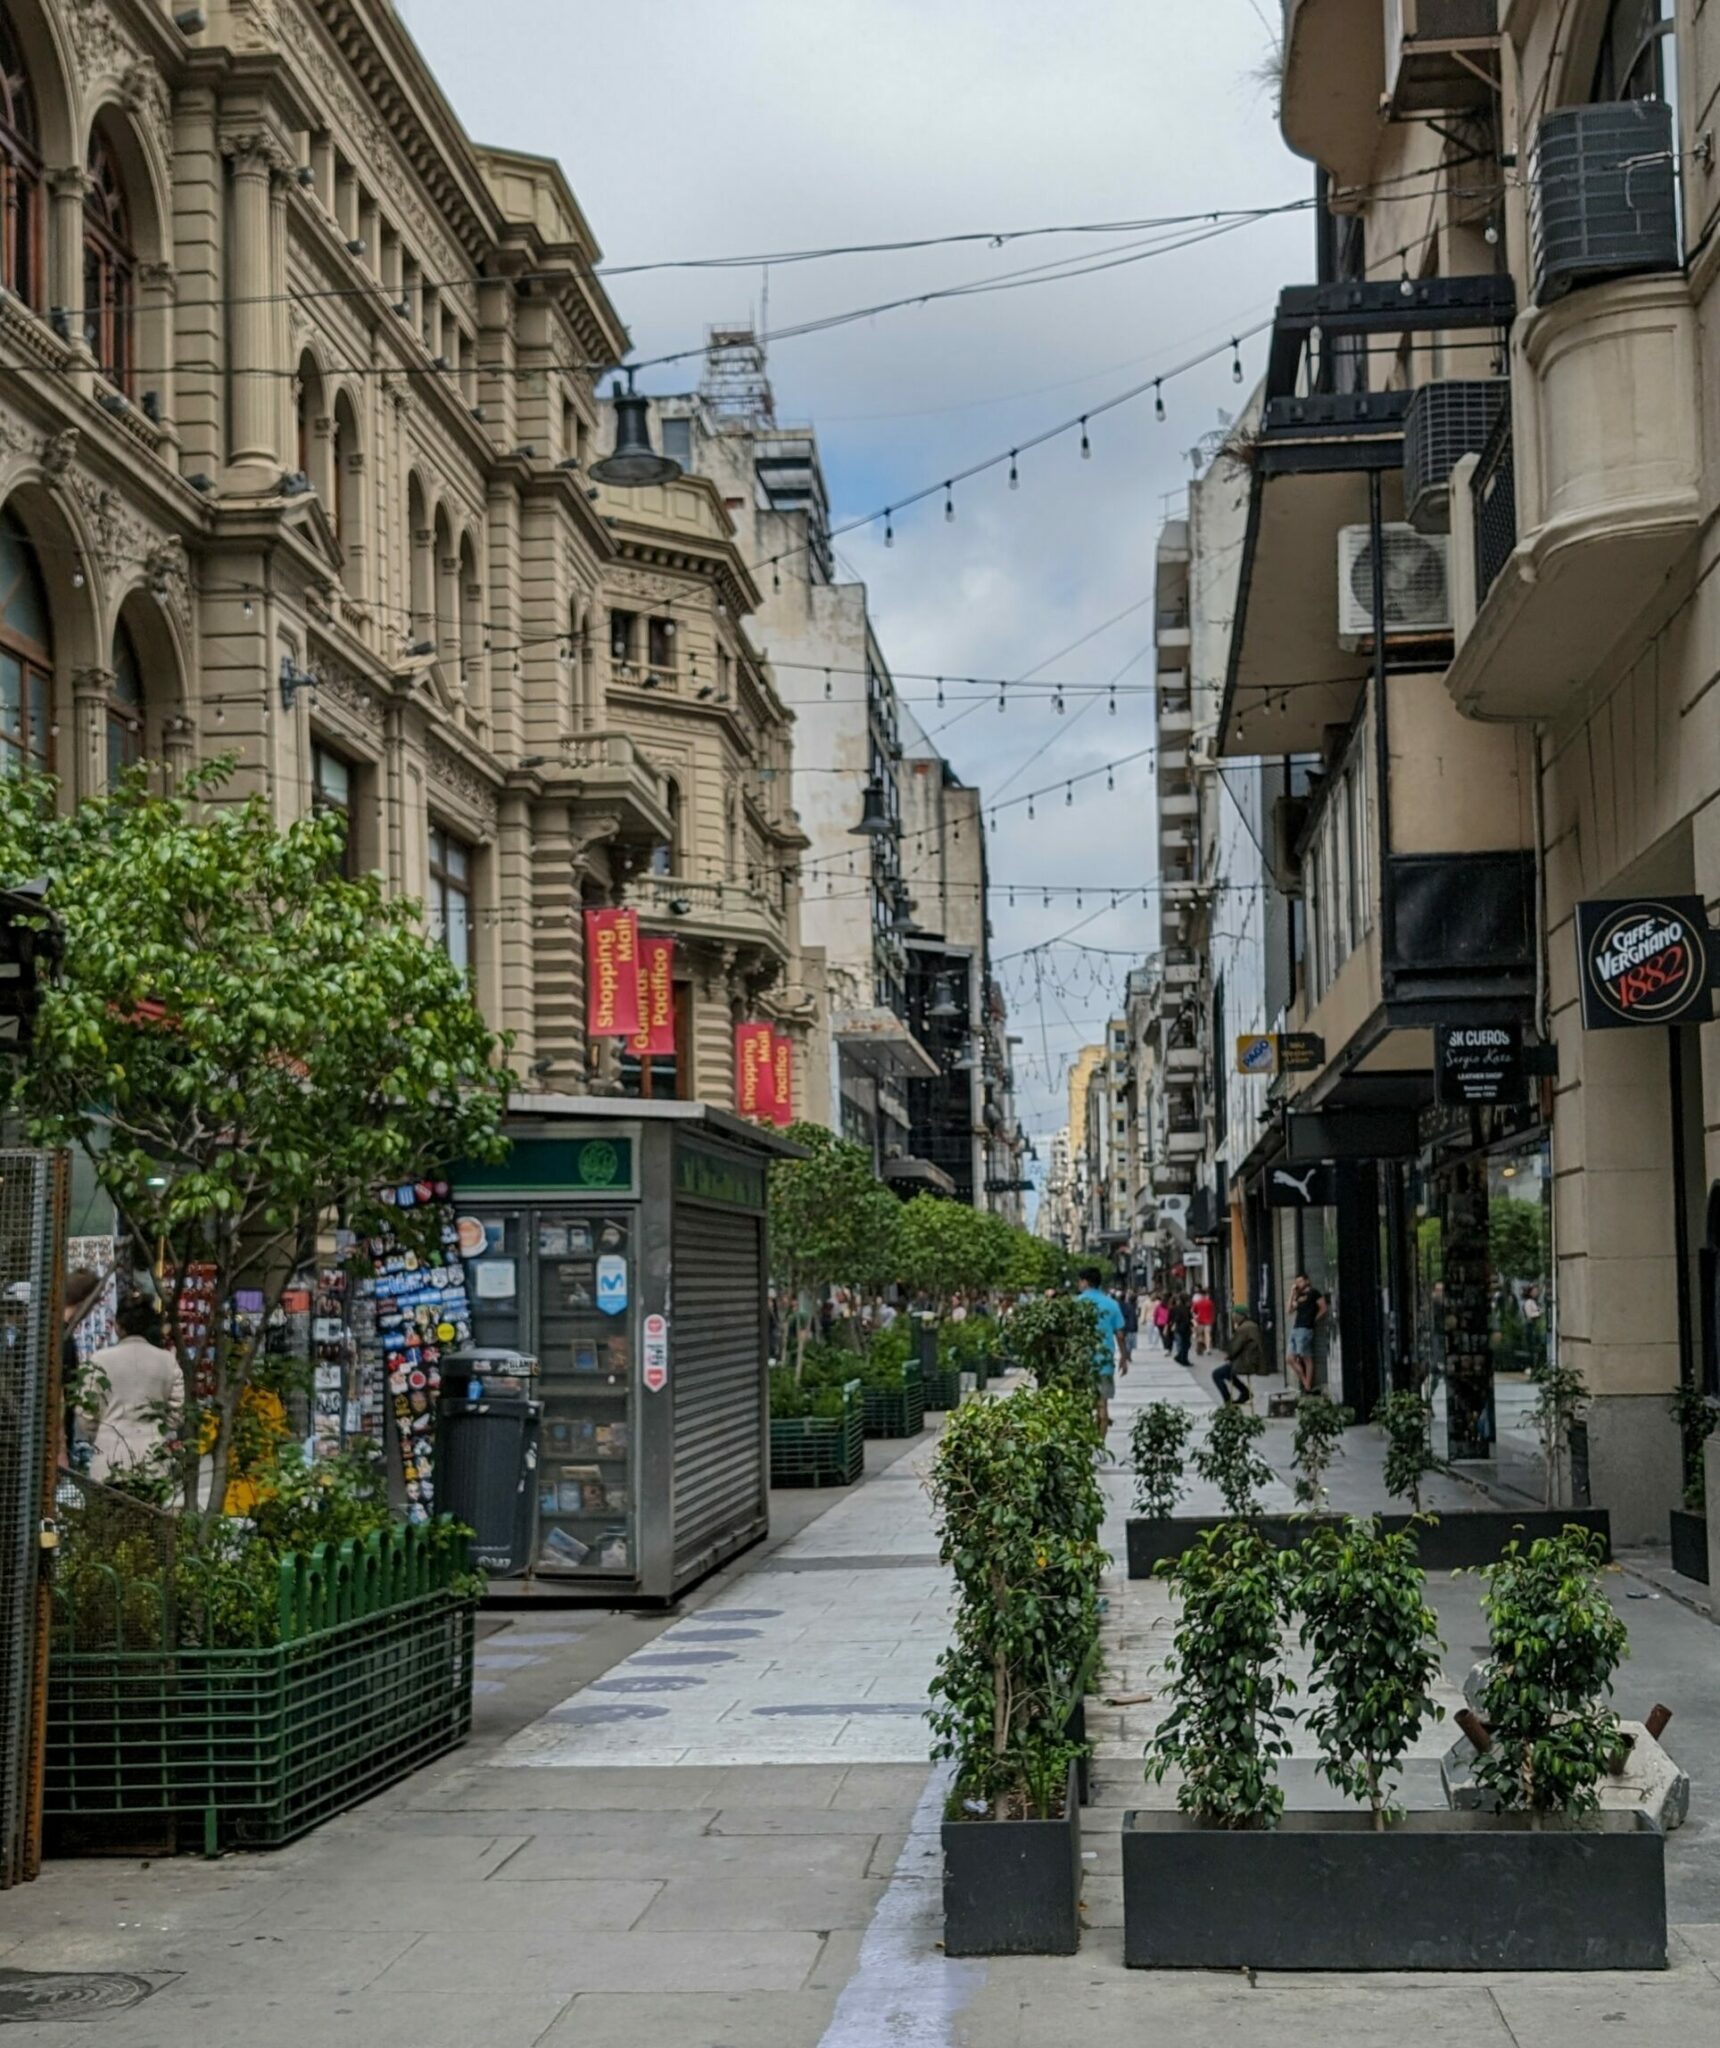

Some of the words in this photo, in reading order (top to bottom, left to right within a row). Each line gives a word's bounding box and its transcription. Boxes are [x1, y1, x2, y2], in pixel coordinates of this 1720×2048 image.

[614, 918, 633, 962] Mall
[1596, 921, 1682, 981] VERGNANO
[596, 929, 619, 1028] Shopping
[1620, 945, 1685, 1008] 1882
[757, 1031, 770, 1063] Mall
[1243, 1040, 1269, 1067] PAGO
[1449, 1031, 1464, 1047] SK
[1465, 1029, 1510, 1046] CUEROS
[743, 1038, 758, 1110] Shopping
